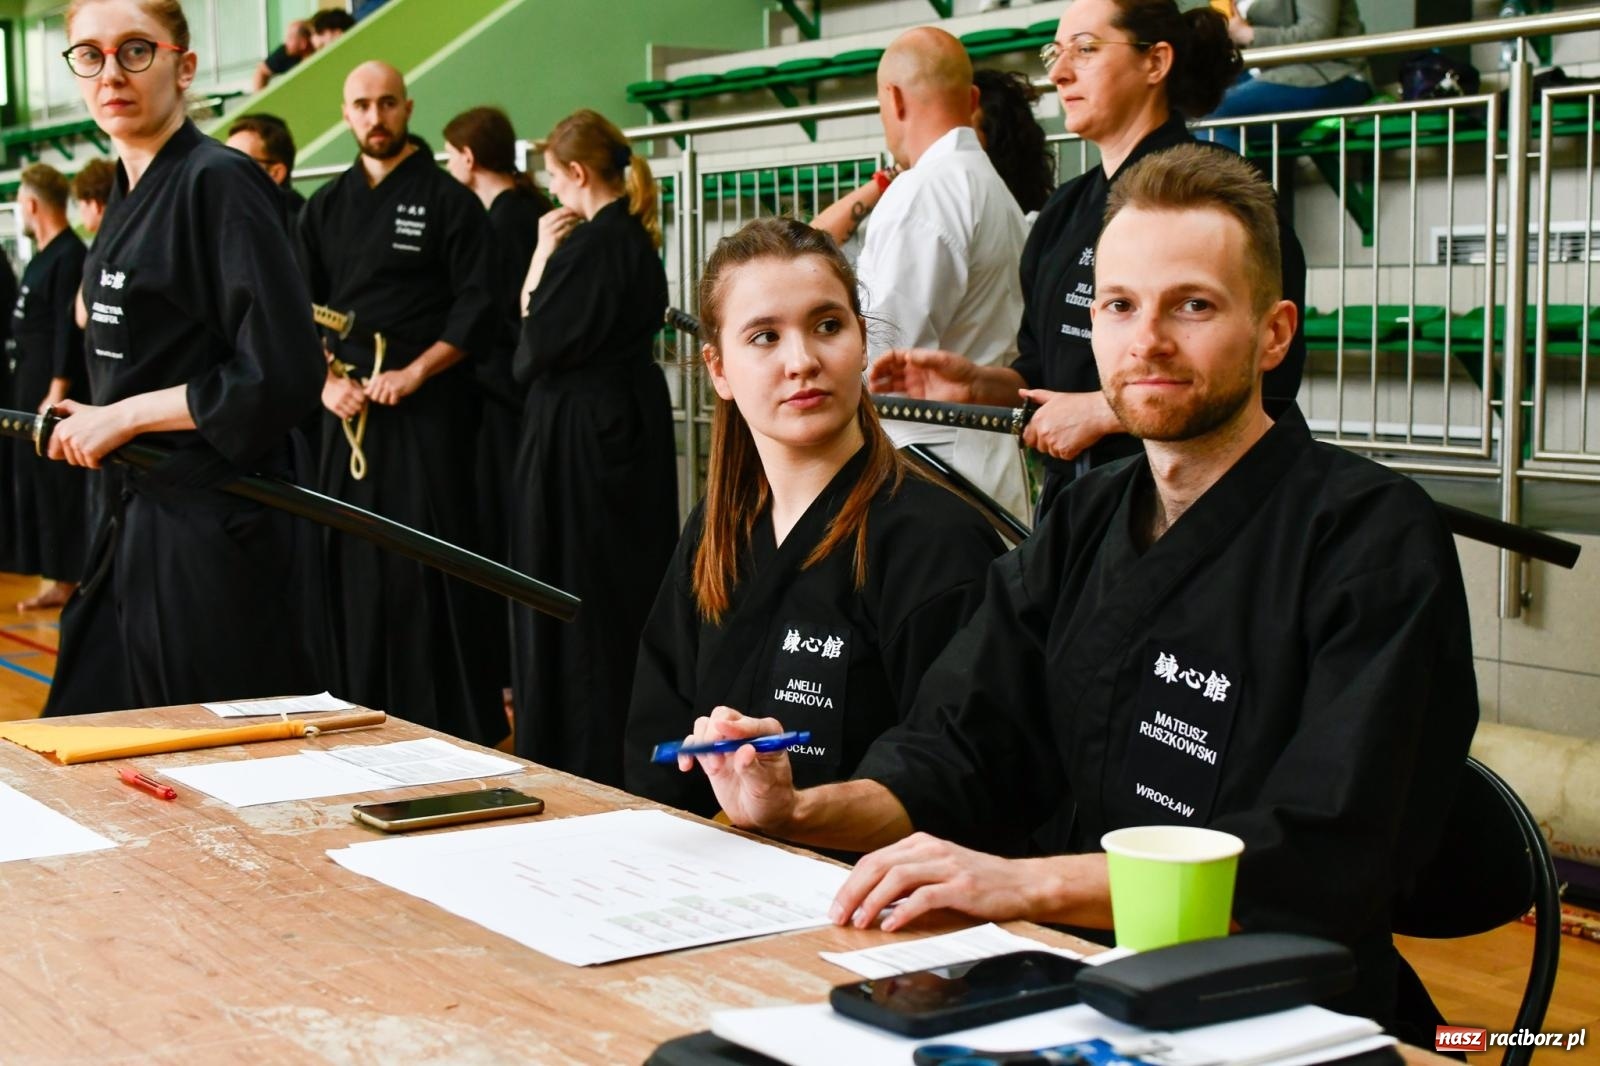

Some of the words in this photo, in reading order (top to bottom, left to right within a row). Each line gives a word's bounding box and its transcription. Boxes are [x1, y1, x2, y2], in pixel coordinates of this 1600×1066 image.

[774, 689, 833, 709] UHERKOVA
[787, 678, 822, 694] ANELLI
[1154, 710, 1208, 744] MATEUSZ
[786, 744, 825, 756] OCŁAW
[1139, 721, 1217, 765] RUSZKOWSKI
[1136, 783, 1194, 818] WROCŁAW
